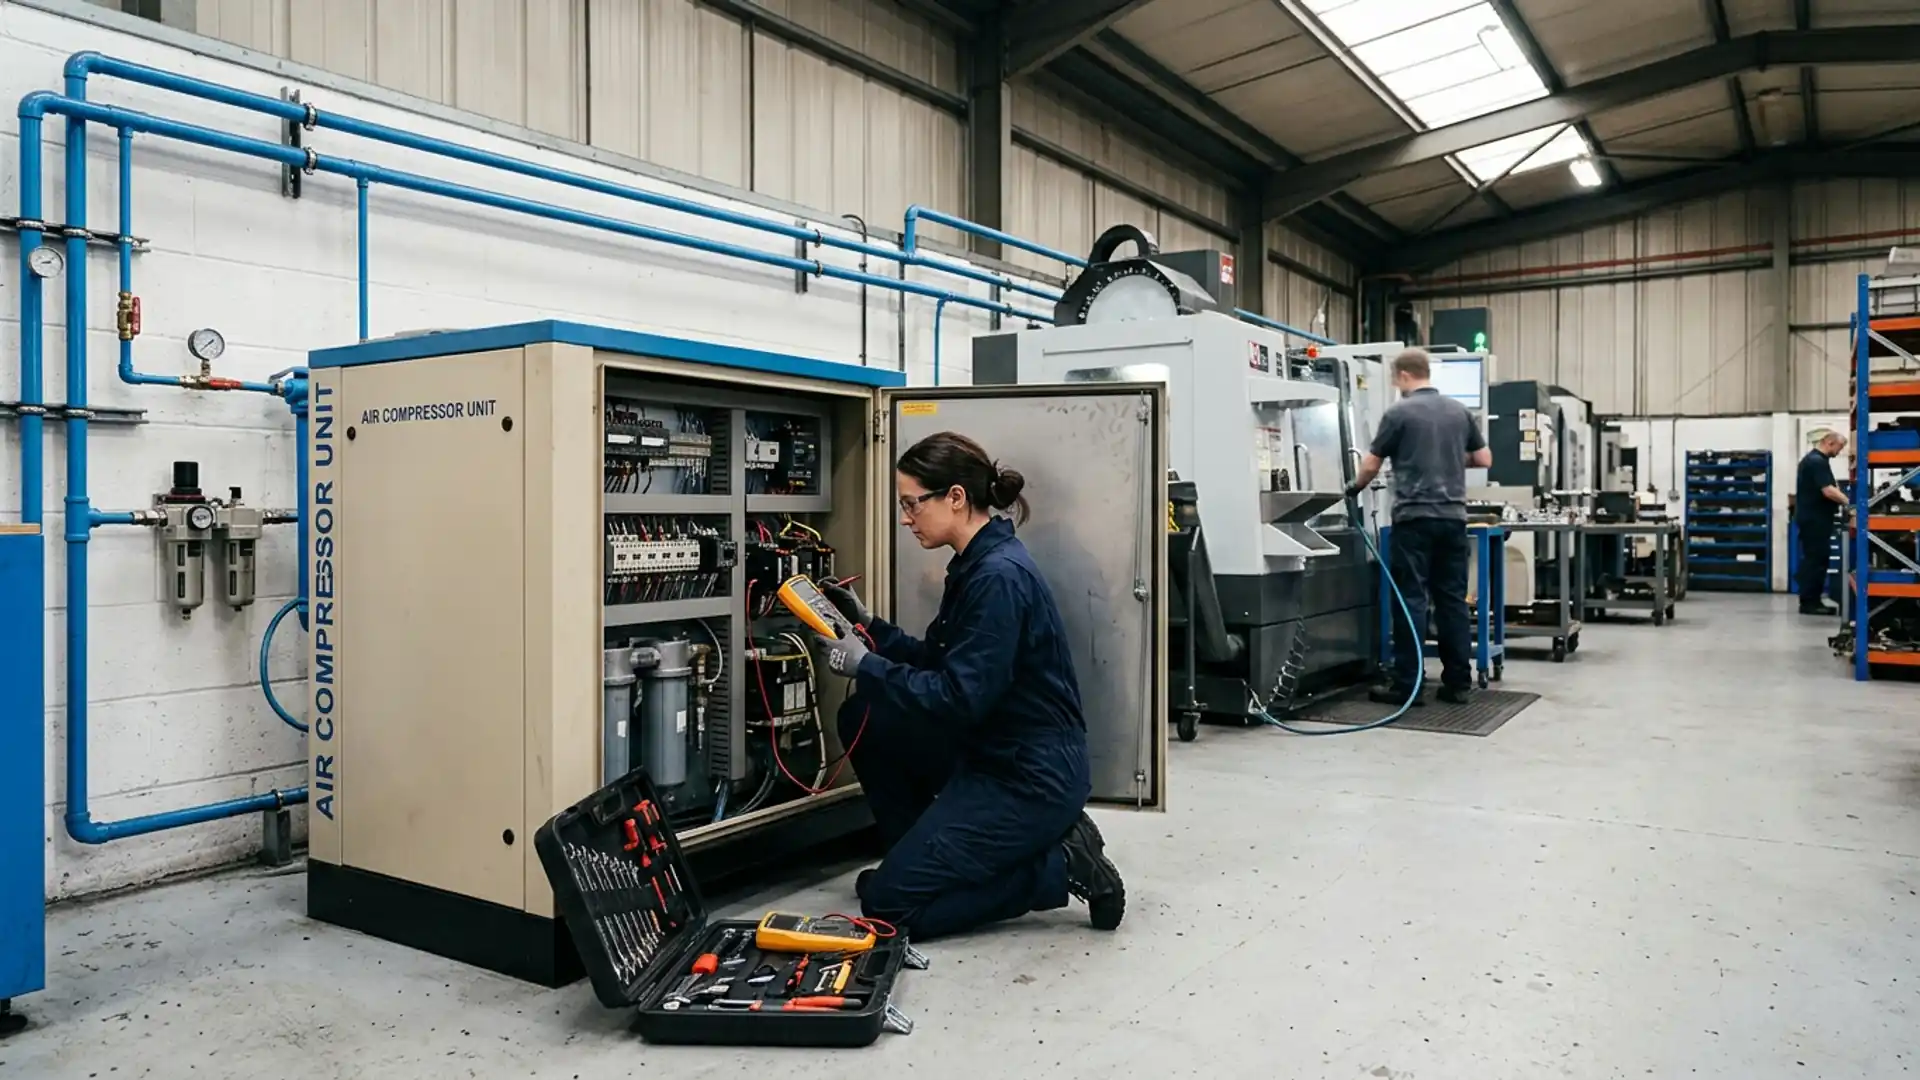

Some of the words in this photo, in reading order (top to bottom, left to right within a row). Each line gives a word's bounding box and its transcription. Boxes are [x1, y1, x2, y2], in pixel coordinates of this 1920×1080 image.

[315, 382, 334, 466] UNIT
[361, 409, 380, 425] AIR
[382, 402, 464, 423] COMPRESSOR
[467, 400, 496, 417] UNIT
[315, 481, 334, 741] COMPRESSOR
[315, 755, 334, 821] AIR
